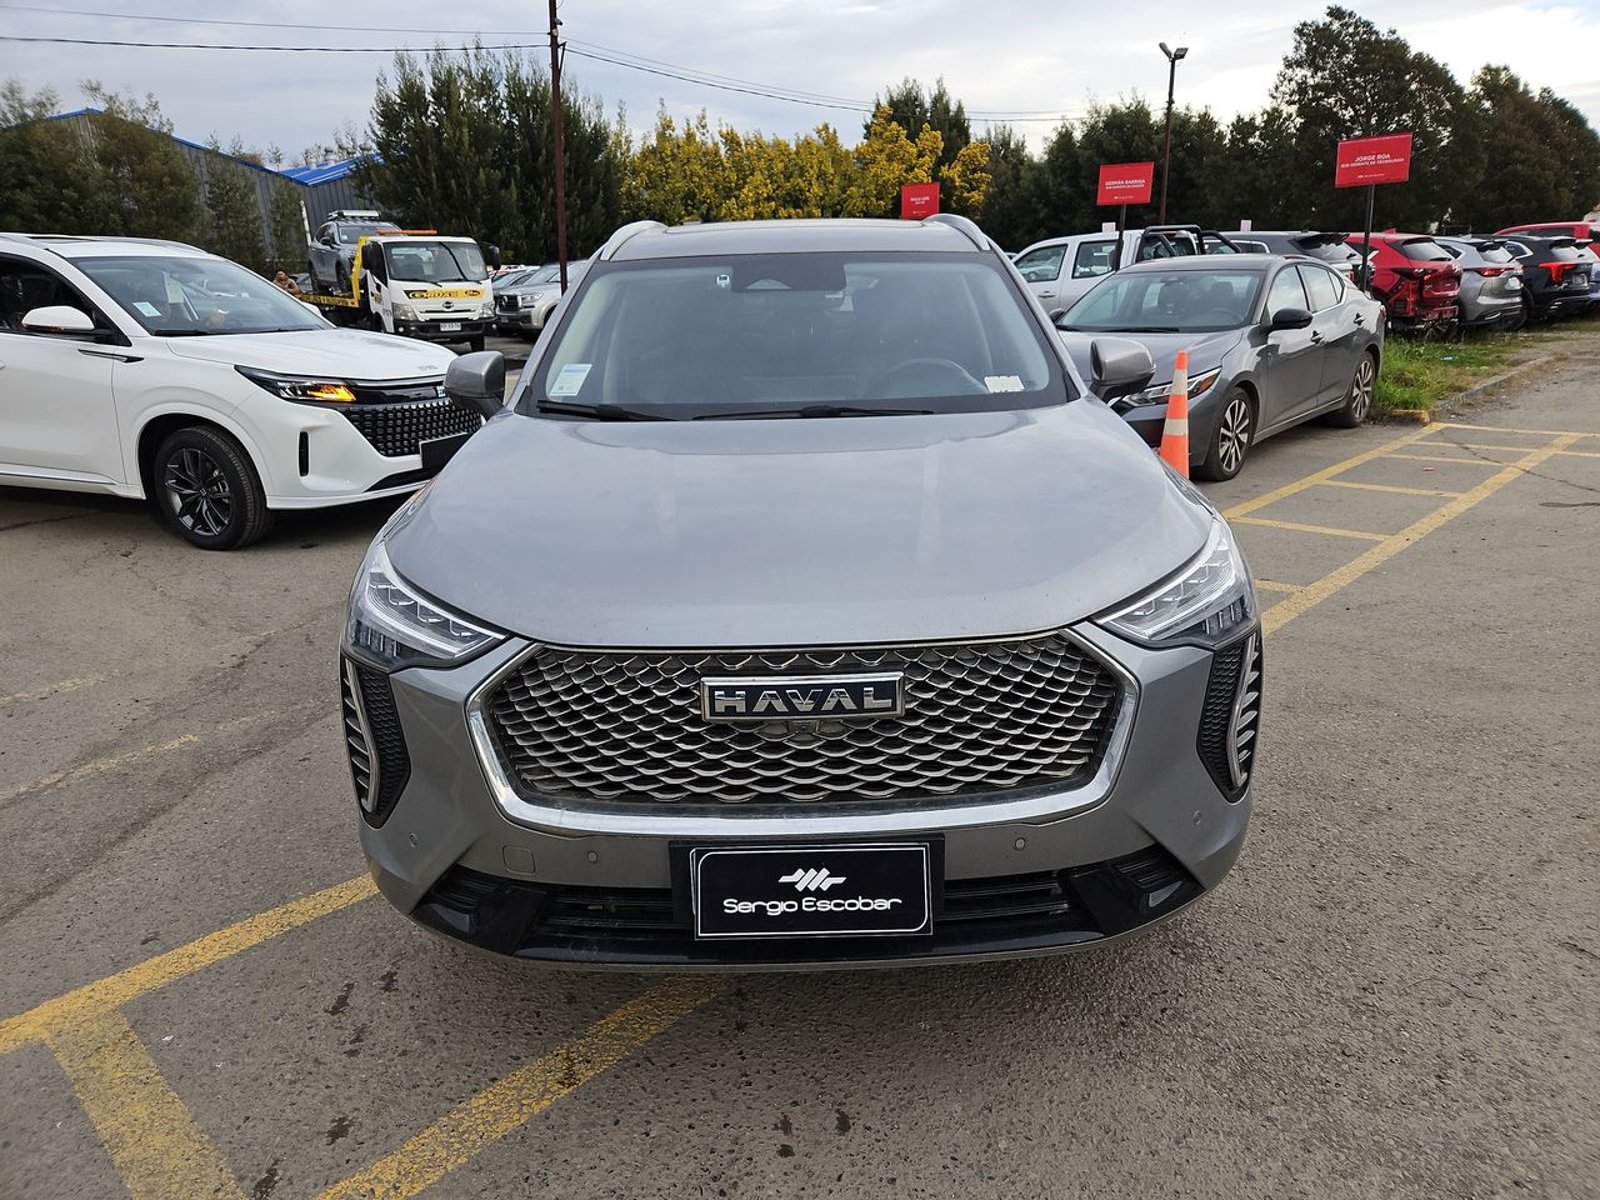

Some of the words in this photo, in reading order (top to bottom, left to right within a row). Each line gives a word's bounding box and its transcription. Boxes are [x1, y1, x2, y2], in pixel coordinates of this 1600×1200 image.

[714, 687, 892, 712] HAVAL
[723, 898, 799, 917] Sergio
[801, 895, 903, 912] Escobar
